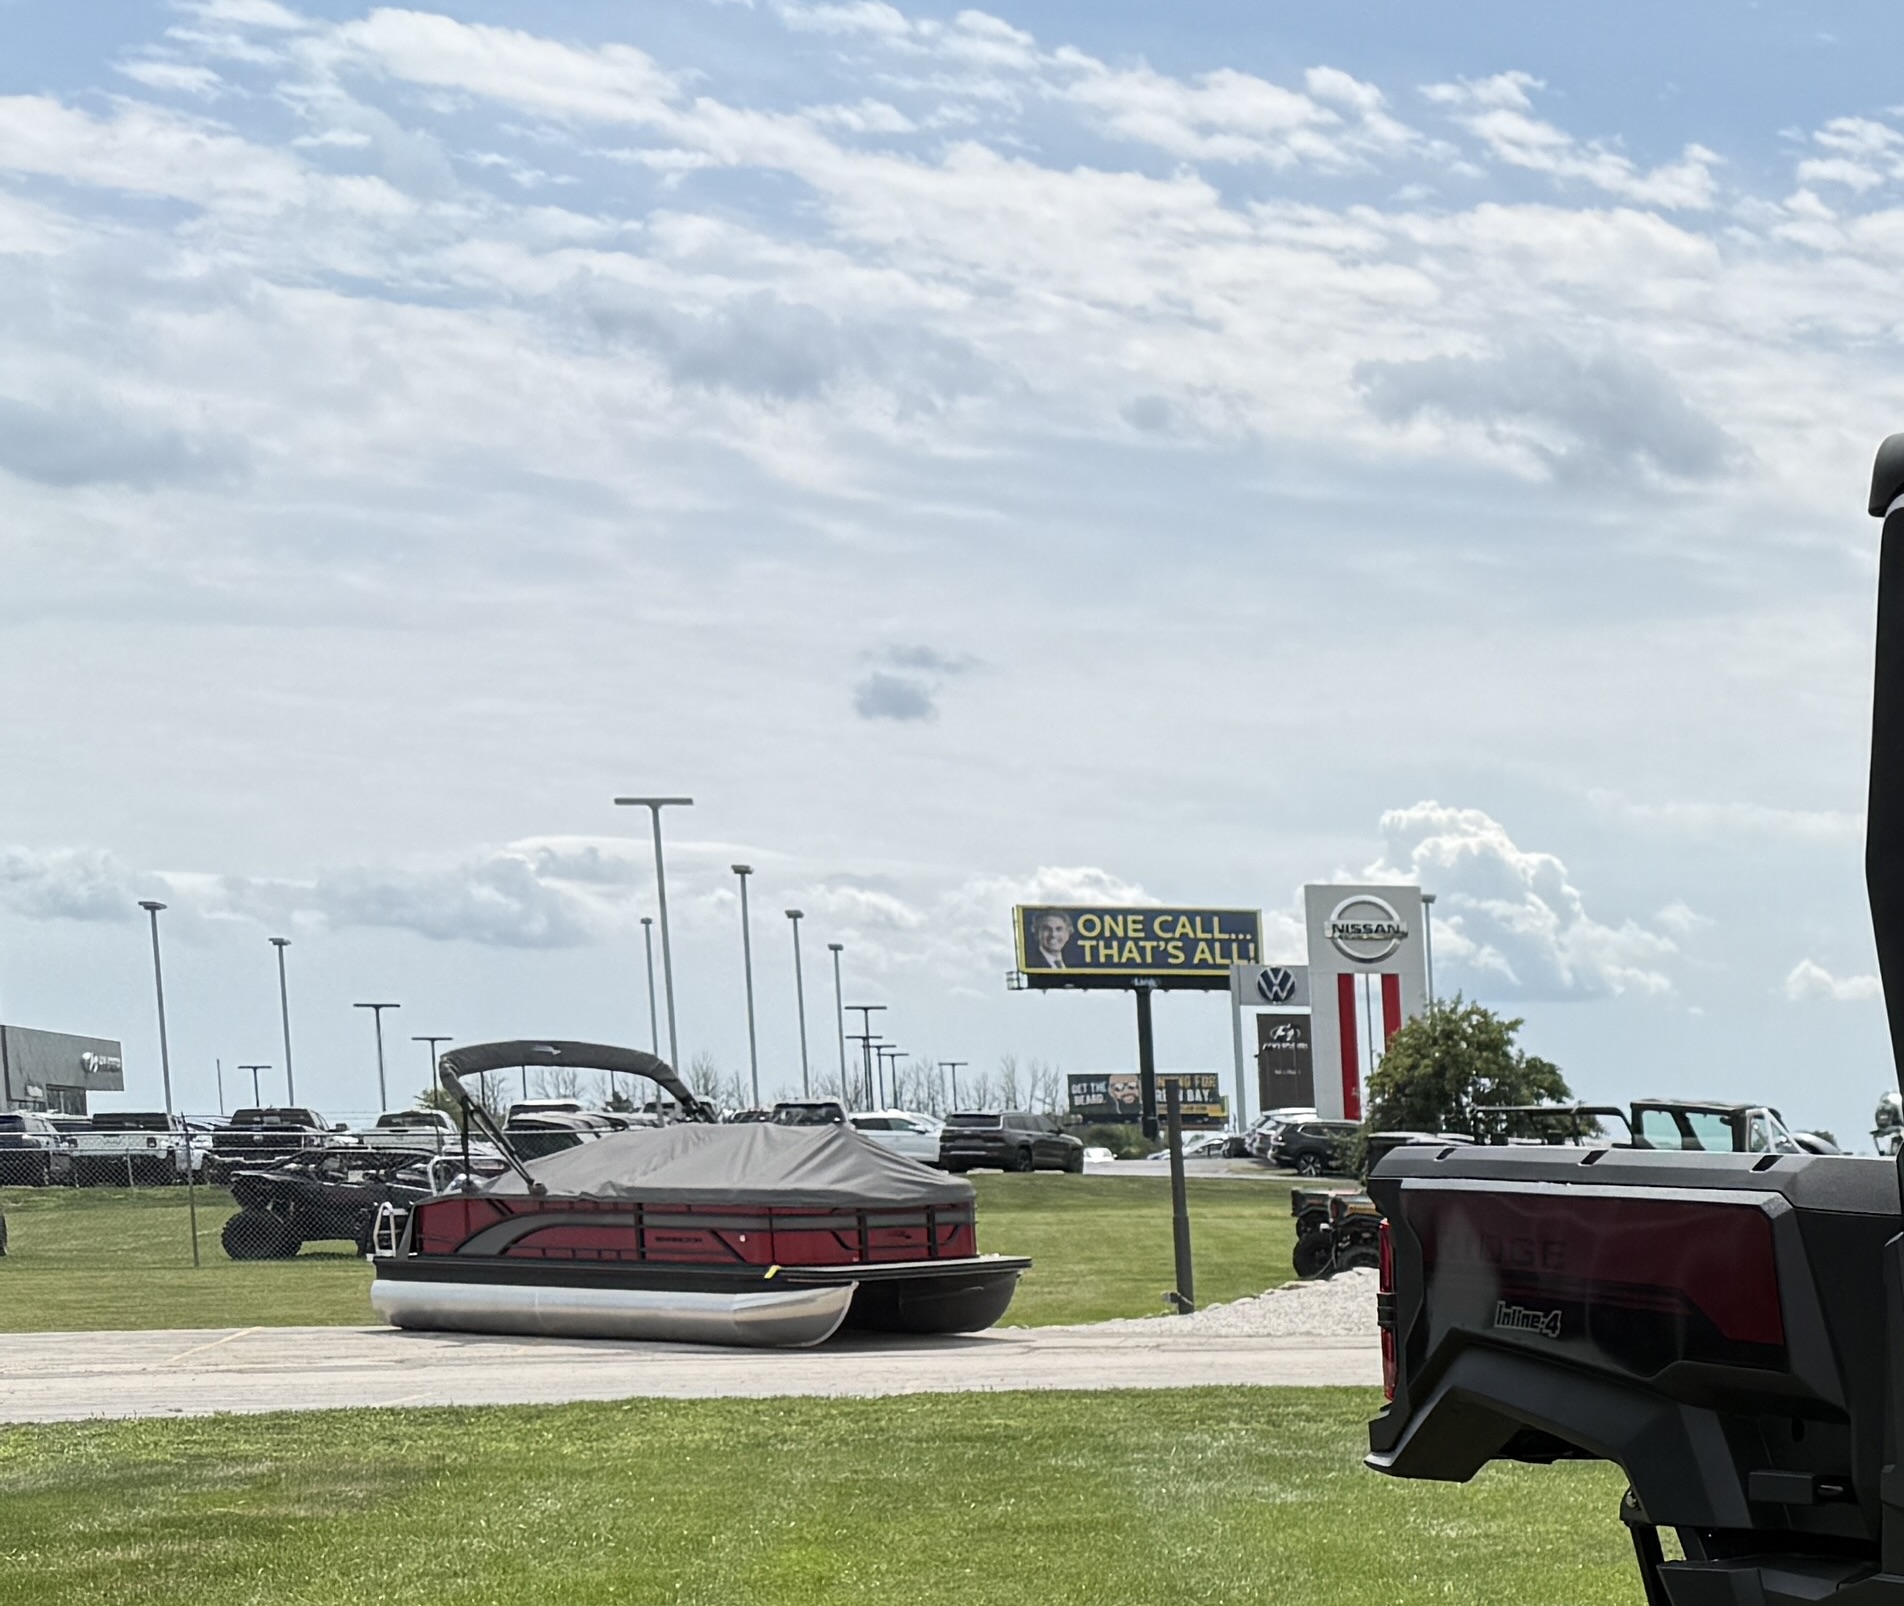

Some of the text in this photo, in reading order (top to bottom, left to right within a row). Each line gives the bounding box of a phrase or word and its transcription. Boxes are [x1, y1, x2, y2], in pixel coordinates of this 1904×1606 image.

[1077, 913, 1252, 940] ONE CALL...
[1332, 923, 1401, 935] NISSAN
[1077, 940, 1256, 966] THAT'S ALL!
[1494, 1300, 1562, 1337] Inline-4
